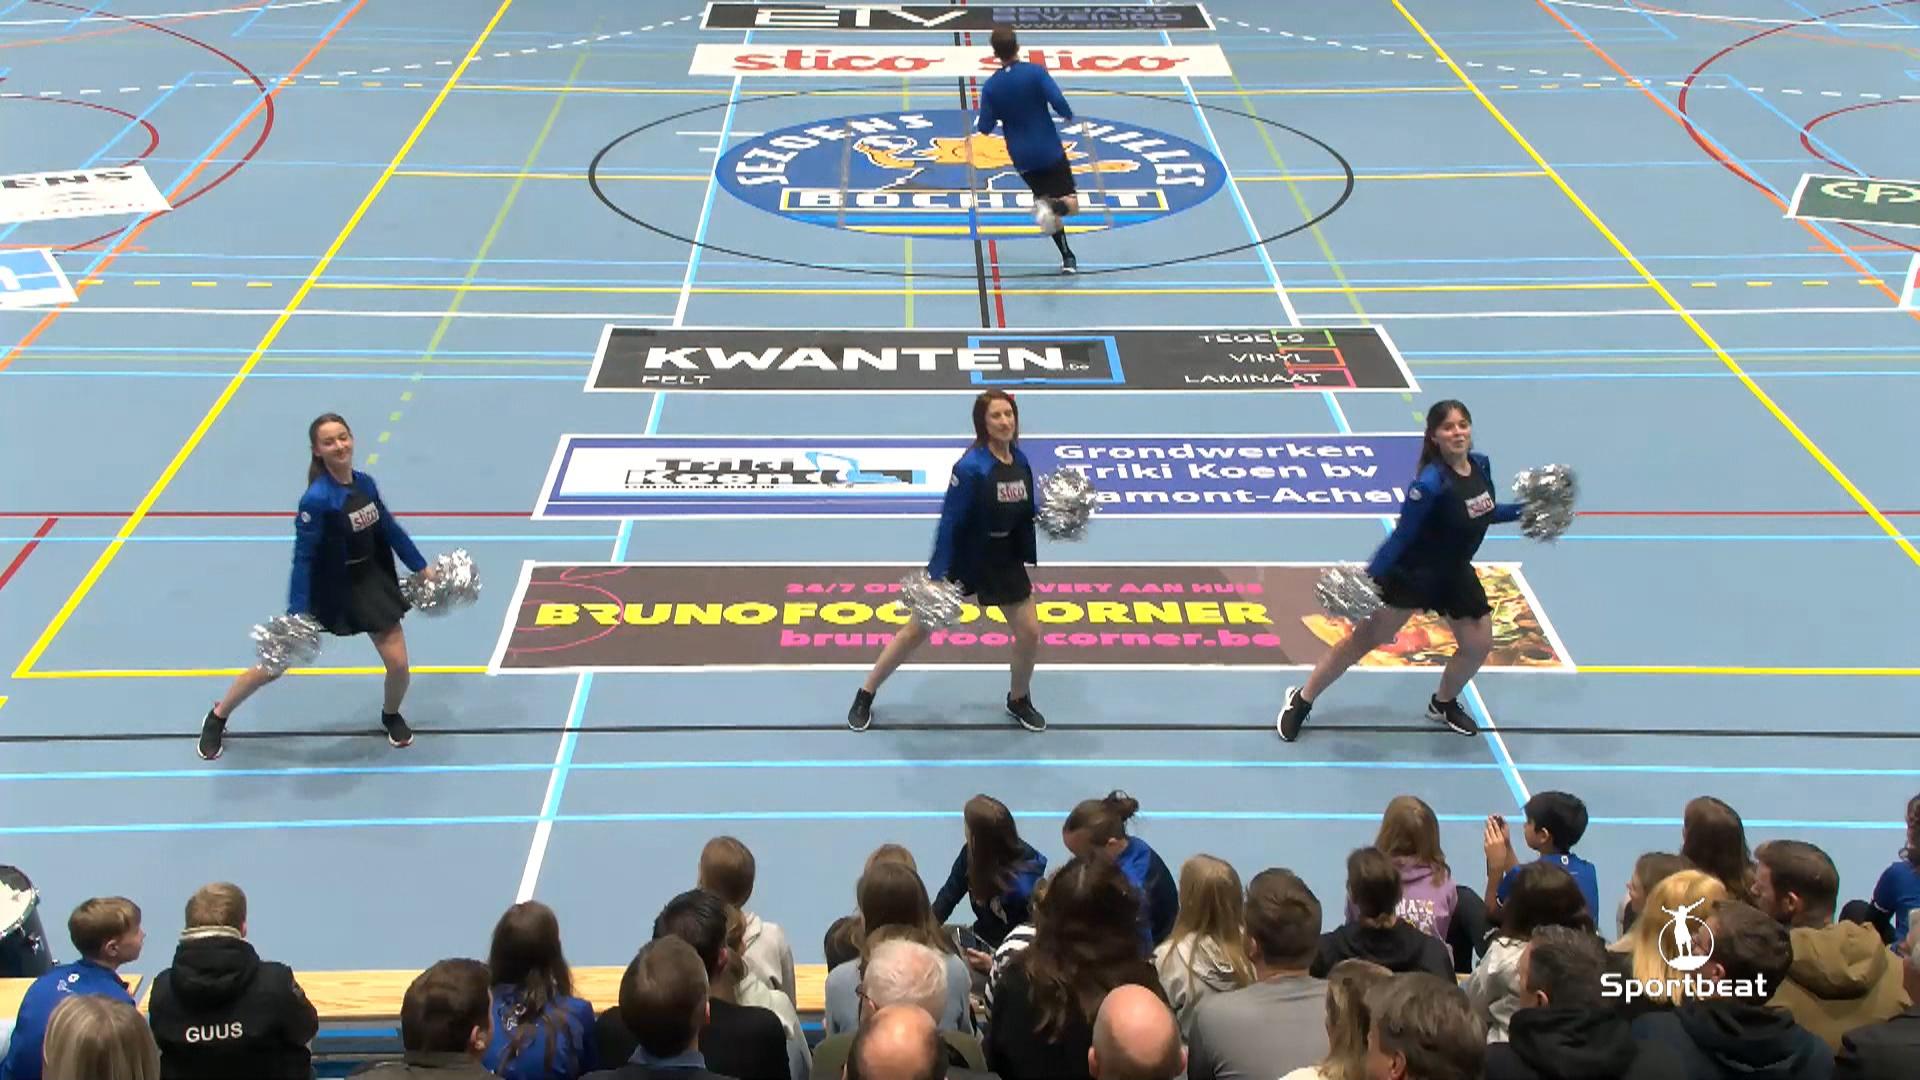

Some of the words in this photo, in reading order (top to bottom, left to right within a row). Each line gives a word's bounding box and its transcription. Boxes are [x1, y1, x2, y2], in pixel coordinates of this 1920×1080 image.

[755, 5, 968, 27] ETV
[732, 49, 945, 71] stico
[1199, 333, 1305, 343] TEGELS
[1229, 353, 1311, 363] VINYL
[1184, 374, 1321, 383] LAMINAAT
[1054, 443, 1375, 459] Grondwerken
[1065, 463, 1173, 479] Triki
[1188, 463, 1306, 479] Koen
[1320, 463, 1378, 478] bv
[1095, 487, 1405, 503] amont-Achel
[786, 583, 856, 593] 24/7
[1120, 583, 1184, 593] AAN
[1192, 583, 1264, 593] HUIS
[185, 1021, 243, 1043] GUUS
